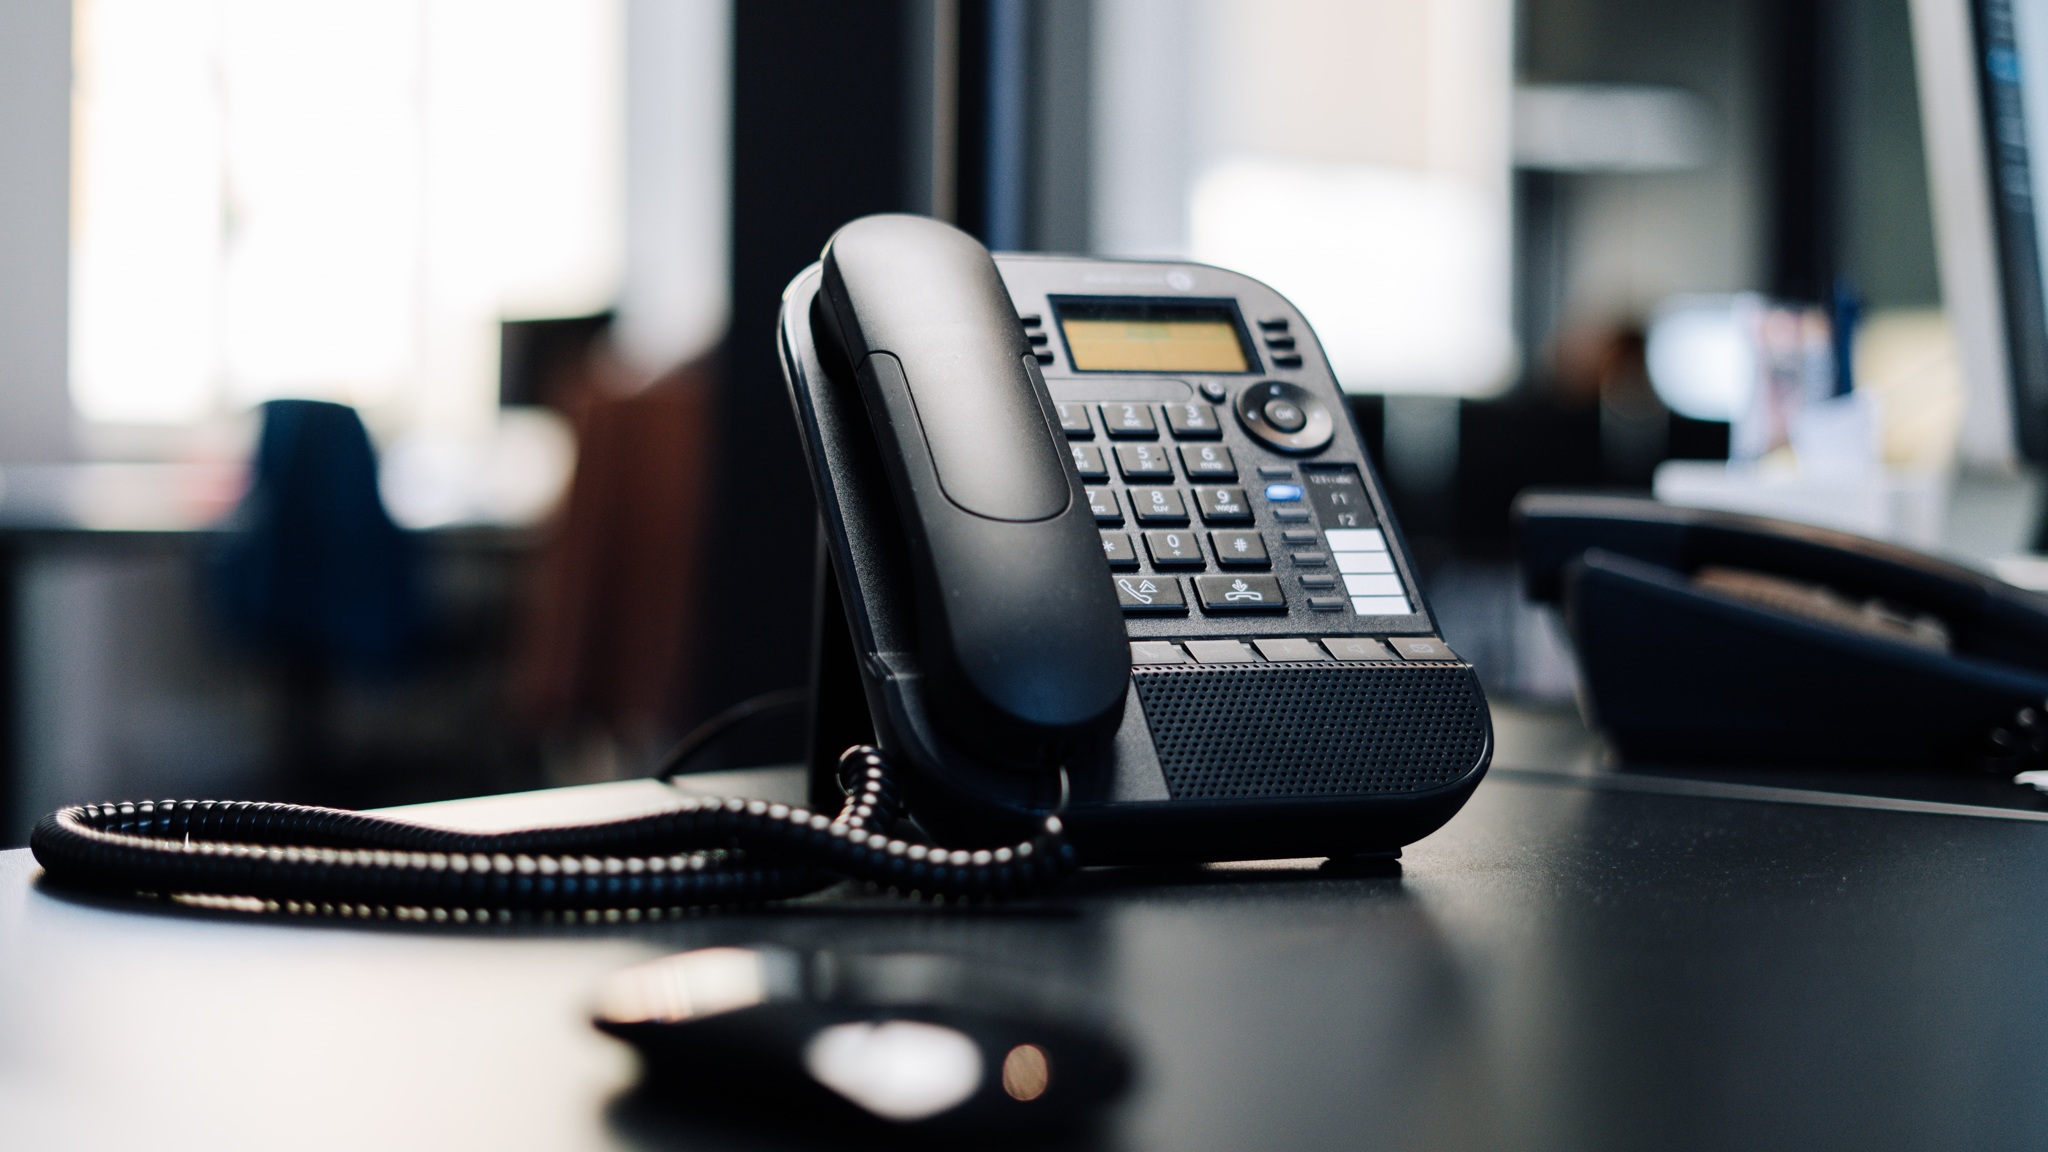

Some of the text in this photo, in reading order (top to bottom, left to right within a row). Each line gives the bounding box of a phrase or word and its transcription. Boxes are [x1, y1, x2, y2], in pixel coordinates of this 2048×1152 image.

[1060, 406, 1067, 417] 1
[1123, 406, 1136, 418] 2
[1185, 406, 1198, 418] 3
[1276, 408, 1295, 420] OK
[1073, 447, 1084, 460] 4
[1137, 447, 1149, 460] 5
[1202, 448, 1214, 460] 6
[1087, 492, 1095, 503] 7
[1151, 492, 1164, 503] 8
[1217, 492, 1230, 503] 9
[1331, 494, 1347, 504] F1
[1091, 505, 1105, 514] qrs
[1153, 505, 1169, 513] tuv
[1215, 505, 1239, 514] wxyz
[1338, 515, 1355, 525] F2
[1167, 535, 1178, 547] 0
[1234, 539, 1247, 551] #
